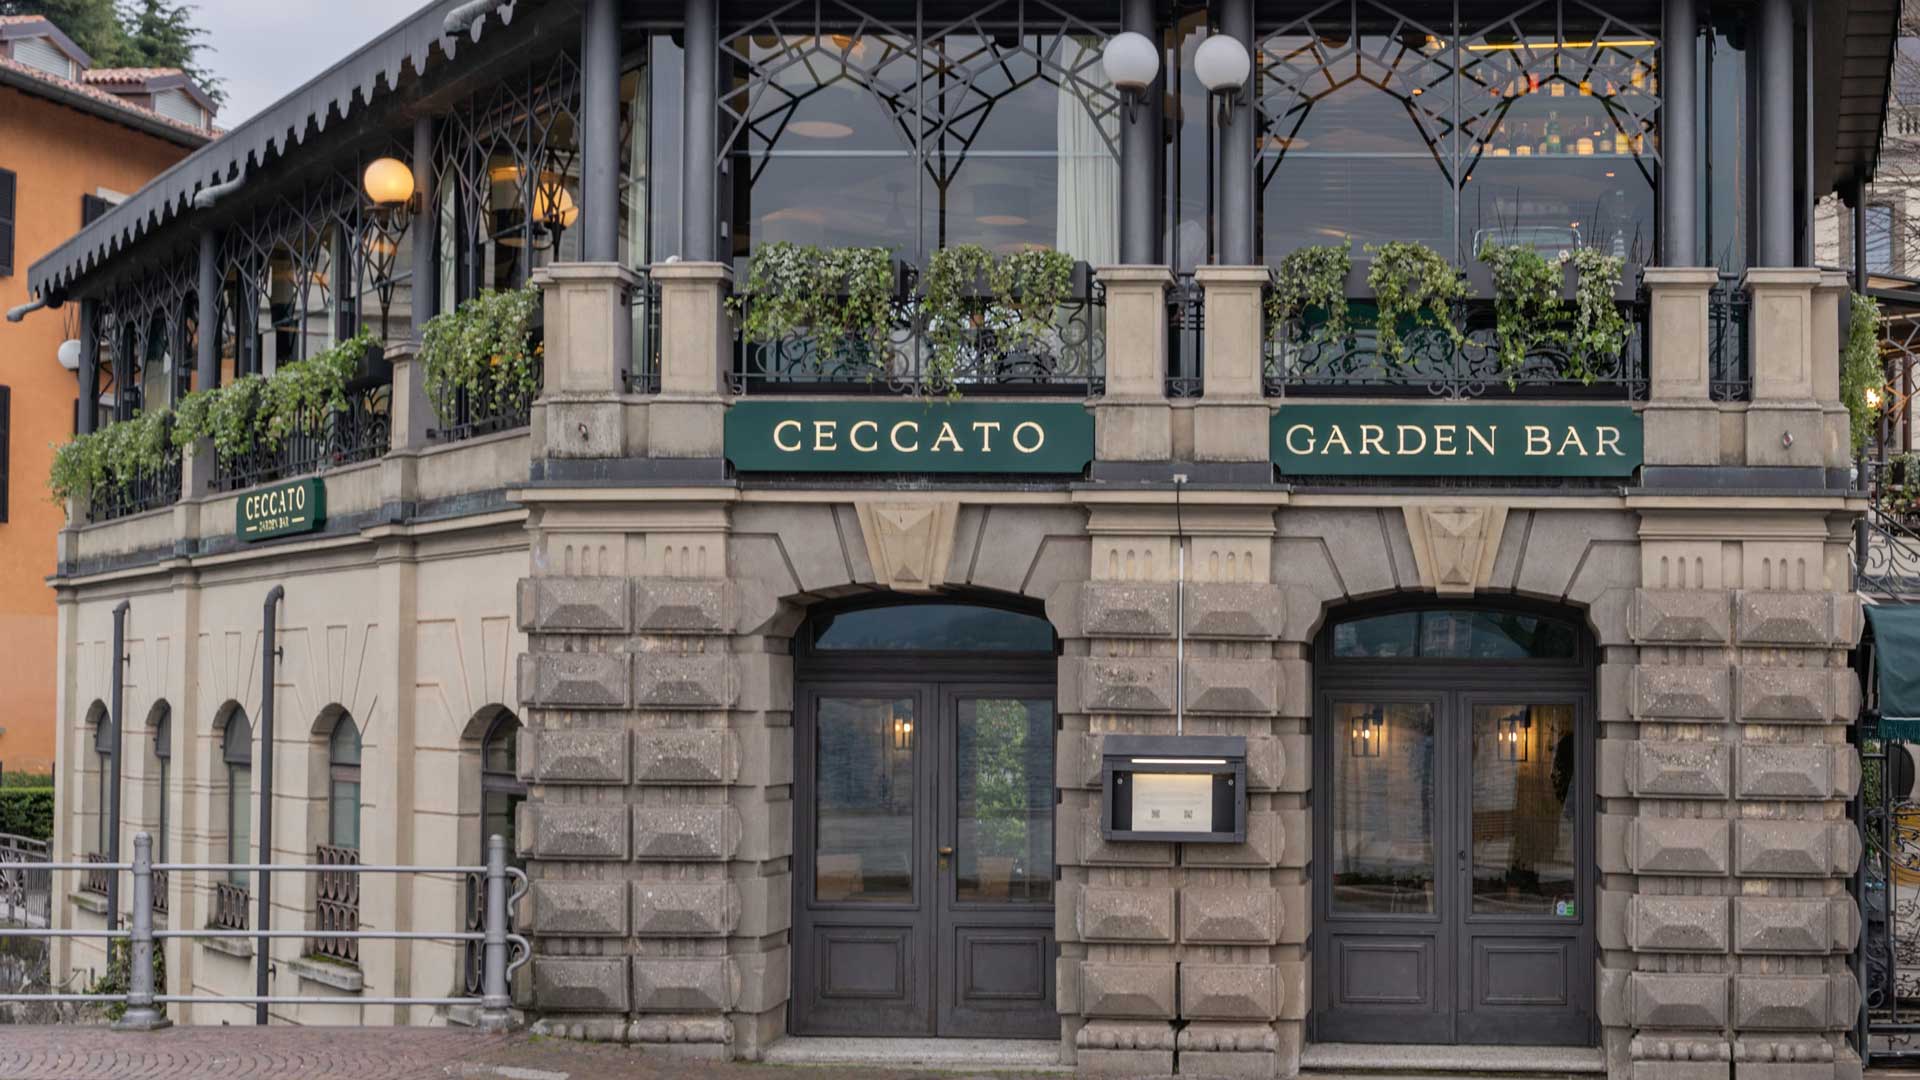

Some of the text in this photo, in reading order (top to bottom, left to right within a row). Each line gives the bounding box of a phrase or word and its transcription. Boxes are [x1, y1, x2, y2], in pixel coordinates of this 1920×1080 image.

[773, 419, 1045, 454] CECCATO
[1285, 423, 1626, 457] GARDEN BAR
[246, 485, 305, 521] CECCATO
